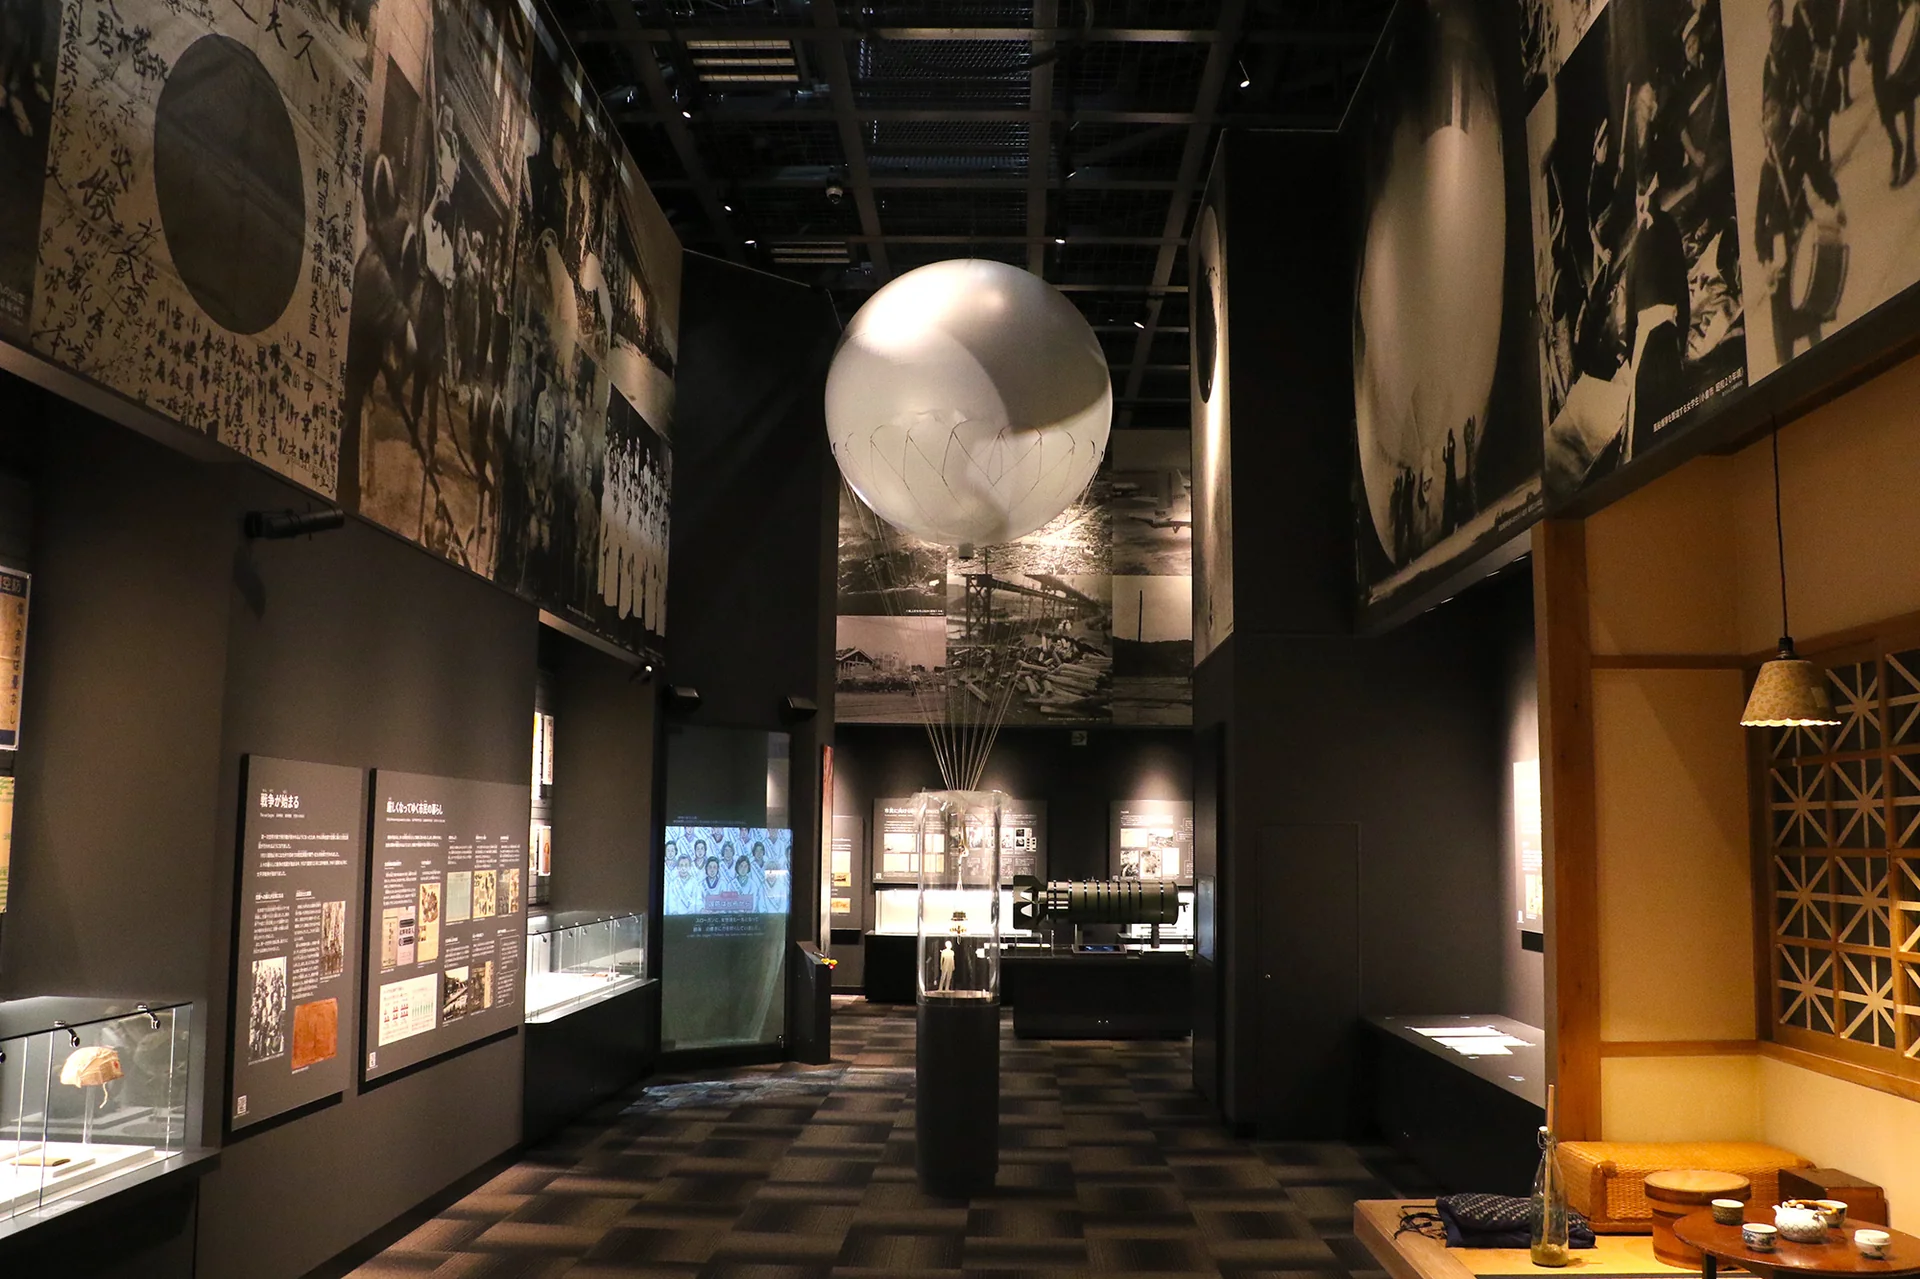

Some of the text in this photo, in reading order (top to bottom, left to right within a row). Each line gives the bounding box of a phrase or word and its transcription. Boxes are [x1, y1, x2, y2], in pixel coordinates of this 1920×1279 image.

[259, 792, 299, 809] 戦争が始まる
